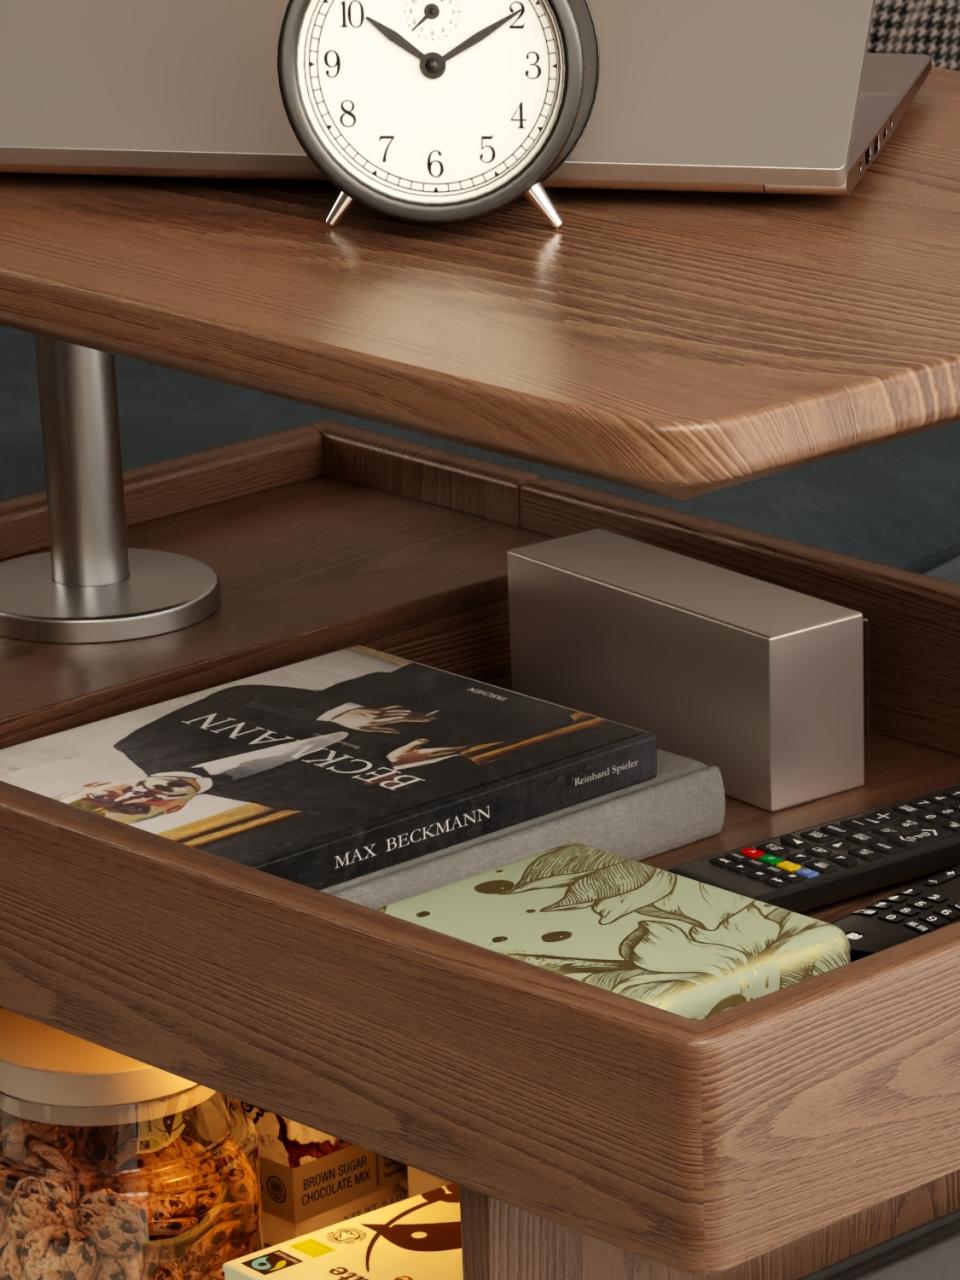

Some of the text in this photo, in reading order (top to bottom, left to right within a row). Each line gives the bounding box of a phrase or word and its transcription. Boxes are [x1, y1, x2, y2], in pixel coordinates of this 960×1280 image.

[341, 0, 364, 28] 10
[509, 1, 526, 29] 2
[324, 50, 341, 78] 9
[525, 52, 542, 80] 3
[340, 100, 357, 127] 8
[510, 102, 527, 129] 4
[379, 136, 395, 163] 7
[479, 136, 496, 163] 5
[427, 150, 445, 178] 6
[573, 758, 640, 788] Reinhard Spieler
[333, 805, 492, 870] MAX BECKMANN
[303, 1155, 369, 1191] BROWN SUGAR
[301, 1178, 353, 1206] CHOCOLATE
[354, 1169, 371, 1185] MIX
